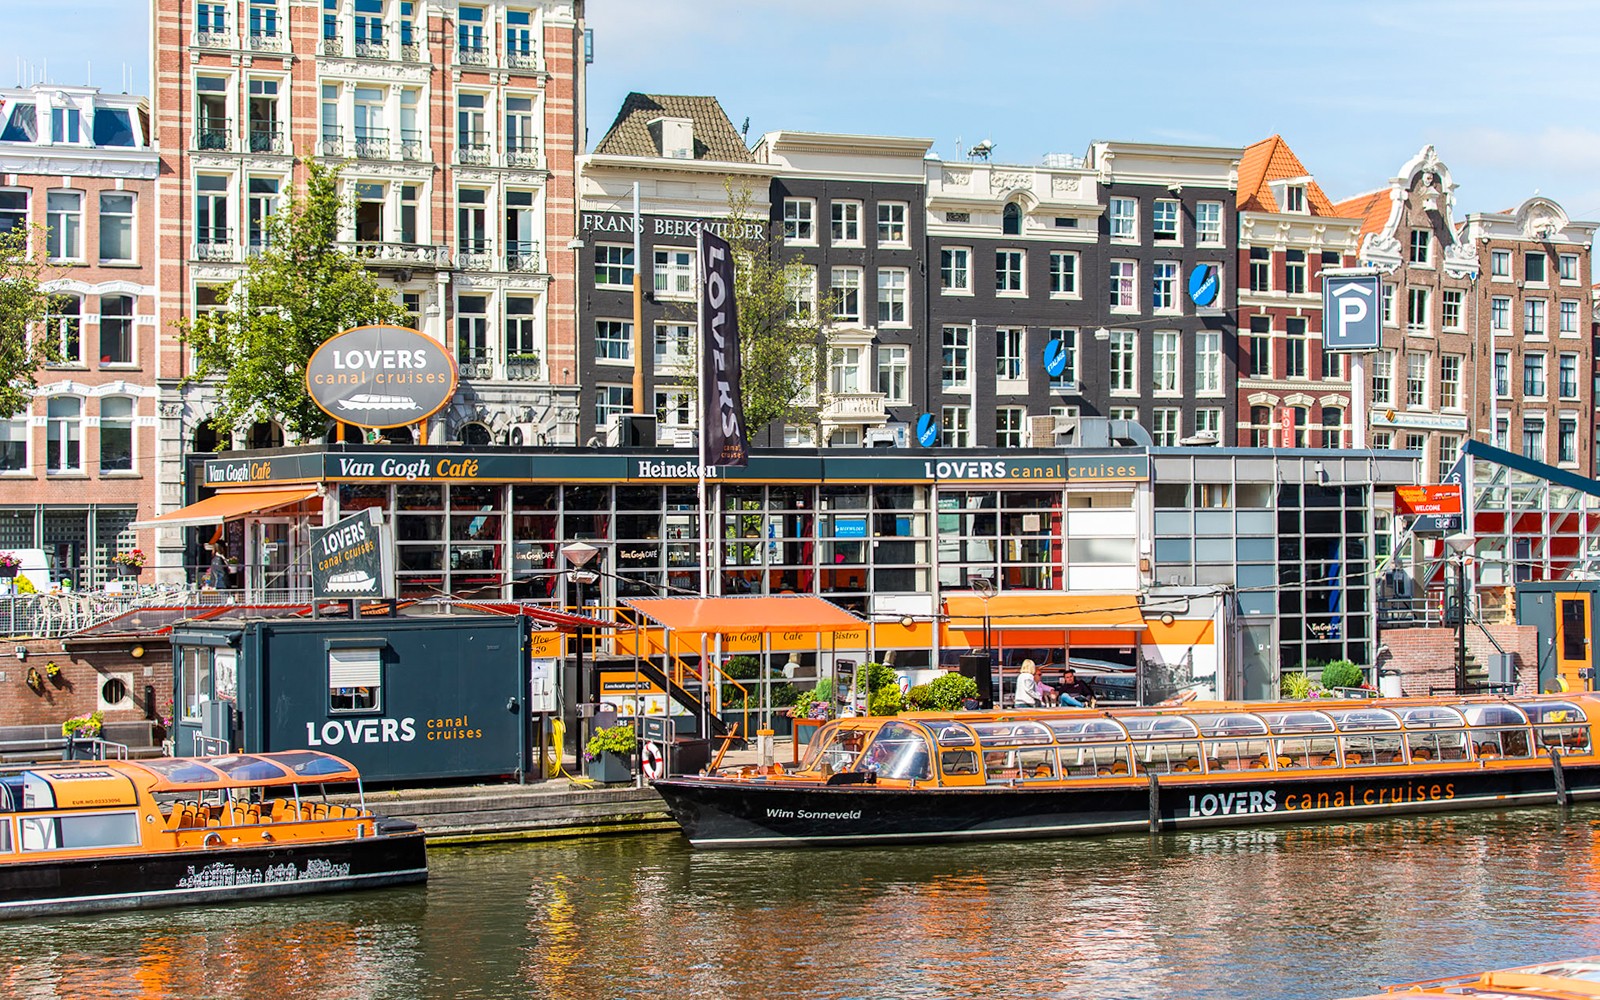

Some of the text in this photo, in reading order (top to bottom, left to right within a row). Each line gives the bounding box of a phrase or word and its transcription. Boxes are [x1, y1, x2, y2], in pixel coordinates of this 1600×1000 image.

[583, 214, 645, 234] FRANS
[1338, 297, 1368, 337] P
[333, 349, 427, 370] LOVERS
[314, 370, 446, 384] canal cruises
[209, 461, 272, 483] Van Gogh Café
[339, 458, 479, 481] Van Gogh Café
[924, 461, 1137, 478] LOVERS canal cruises
[1414, 504, 1441, 512] WELCOME
[322, 520, 366, 555] LOVERS
[318, 540, 375, 571] canal cruises
[530, 634, 550, 645] ffee
[306, 717, 416, 746] LOVERS
[426, 715, 469, 729] canal
[426, 728, 482, 741] cruises
[1188, 781, 1455, 818] LOVERS canal cruises
[766, 808, 862, 820] Wim Sonneveld
